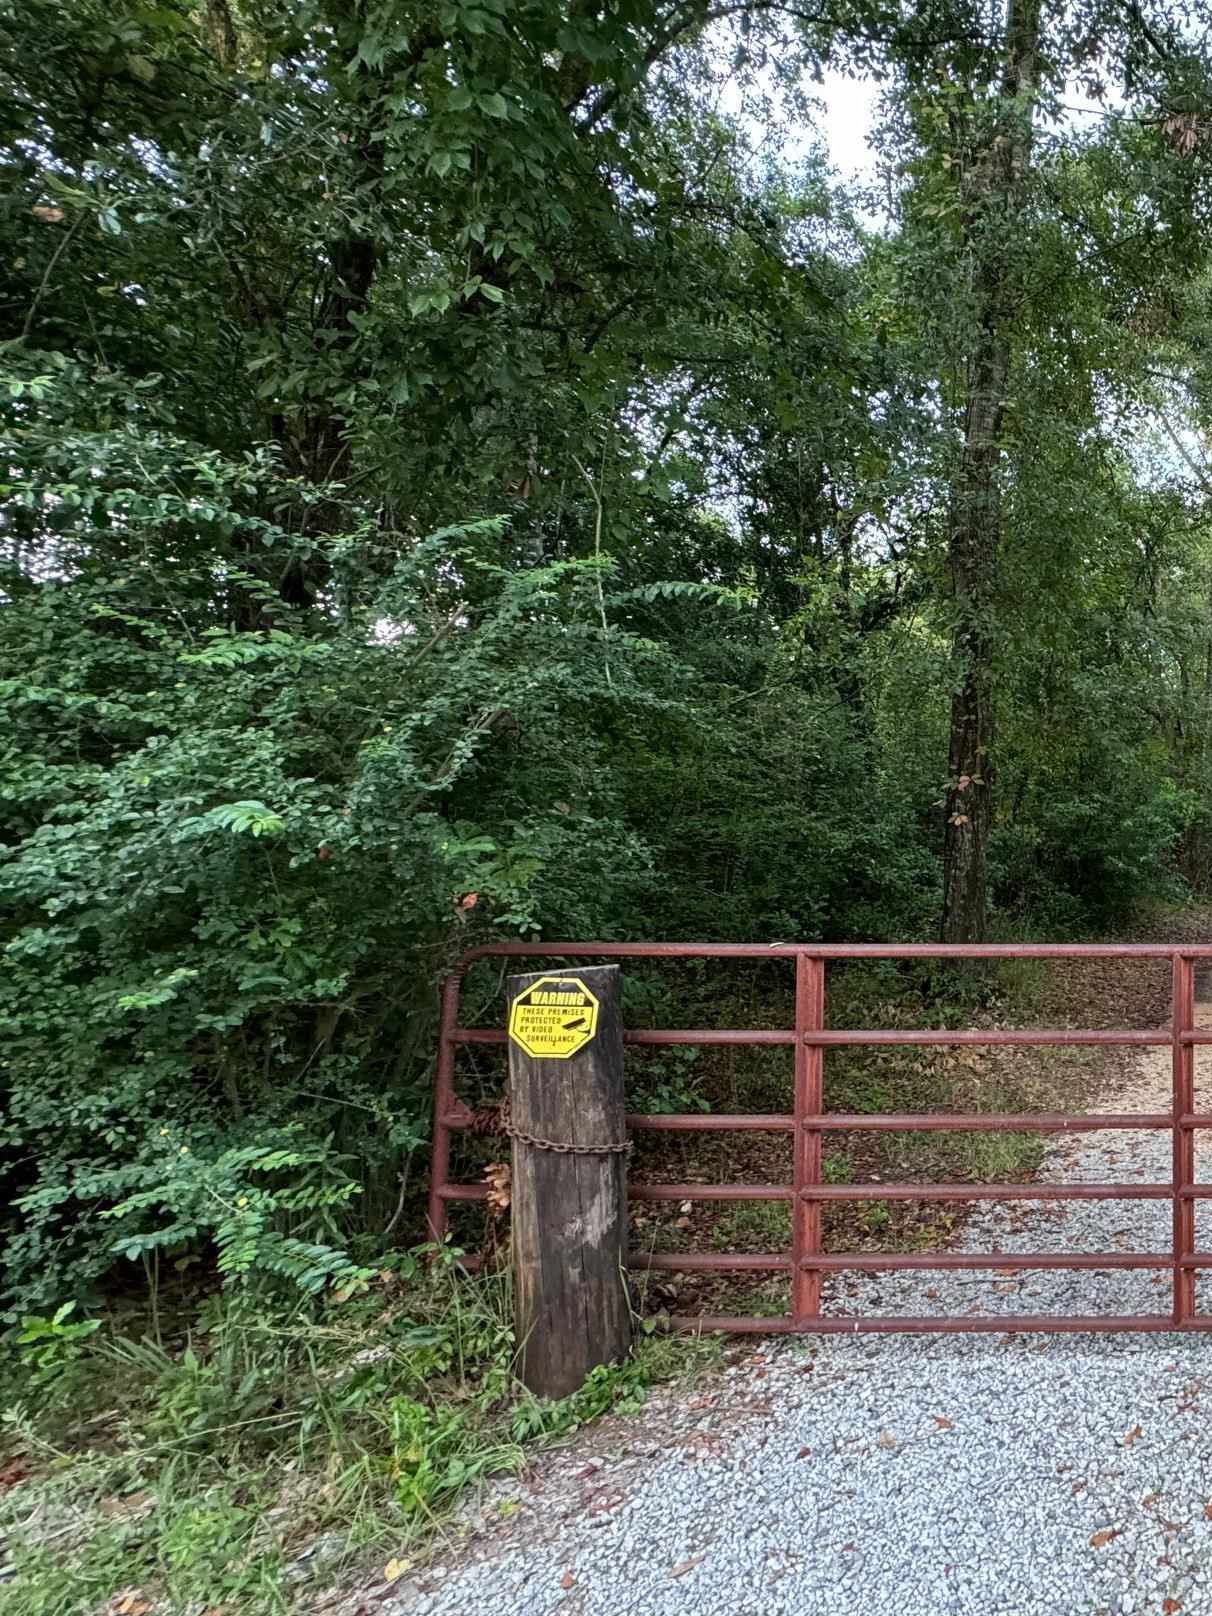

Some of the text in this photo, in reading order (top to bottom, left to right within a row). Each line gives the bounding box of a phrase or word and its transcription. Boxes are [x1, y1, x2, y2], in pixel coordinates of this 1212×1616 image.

[531, 992, 585, 1005] WARNING
[548, 1008, 585, 1016] PREMISES
[521, 1017, 562, 1025] PROTECTED
